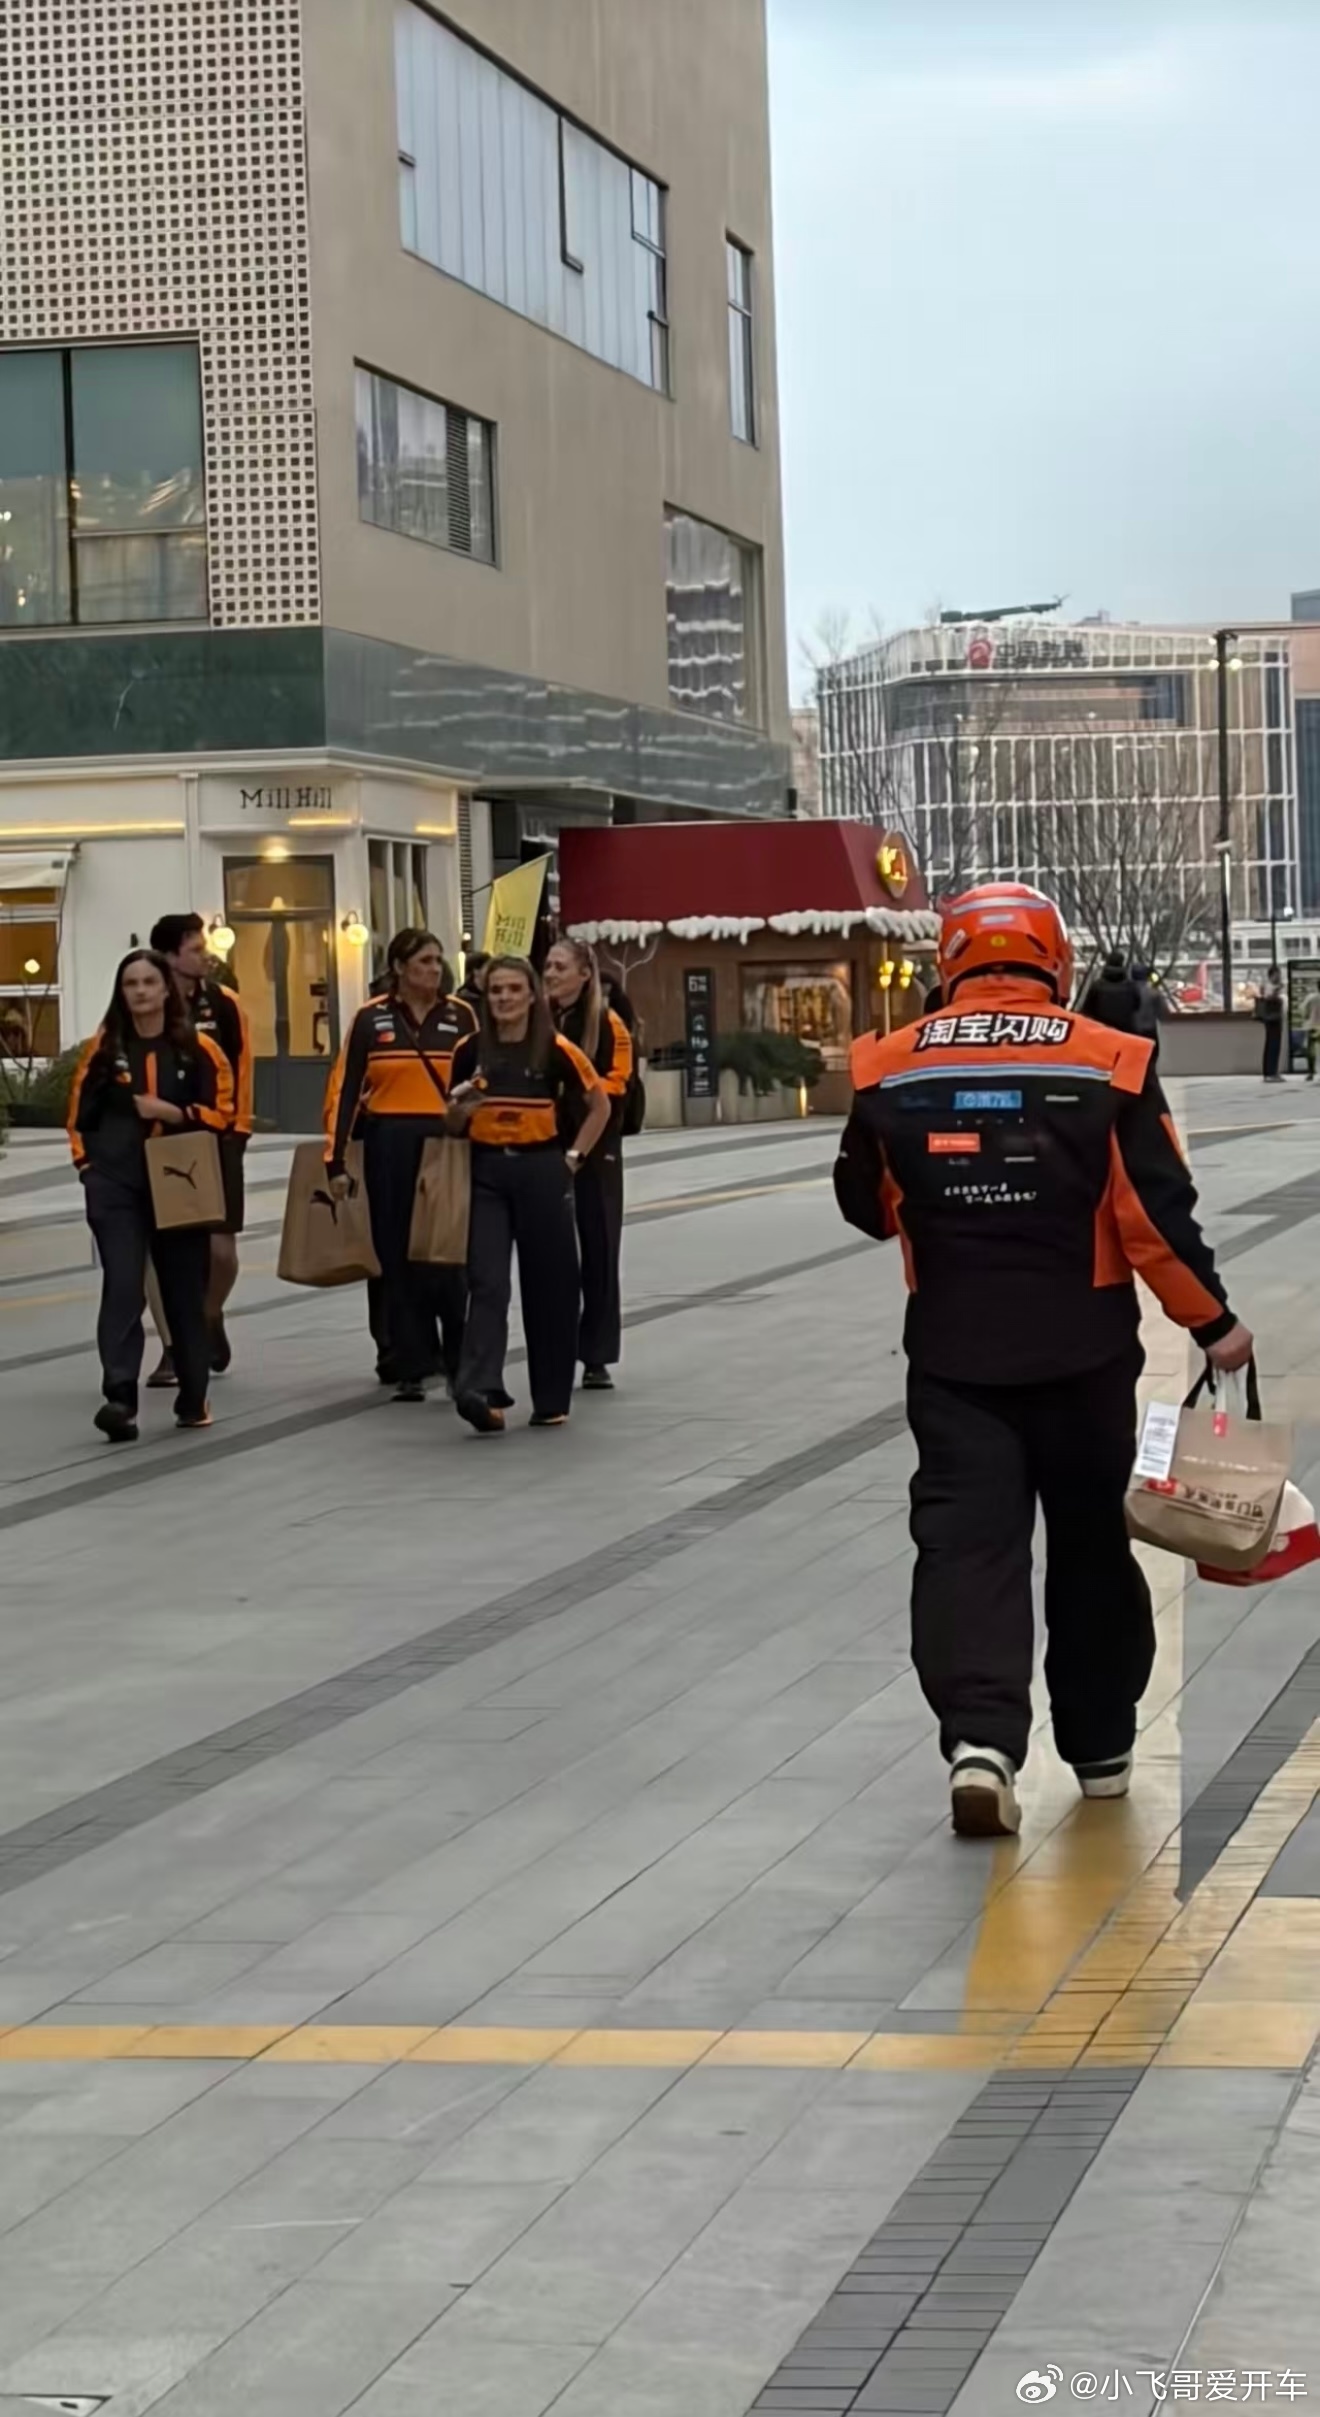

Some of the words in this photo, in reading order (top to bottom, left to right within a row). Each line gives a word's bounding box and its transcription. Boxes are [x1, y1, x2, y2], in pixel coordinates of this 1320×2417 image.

[240, 787, 290, 809] Mill
[296, 786, 331, 809] Hill
[918, 1012, 1070, 1049] 淘宝闪购
